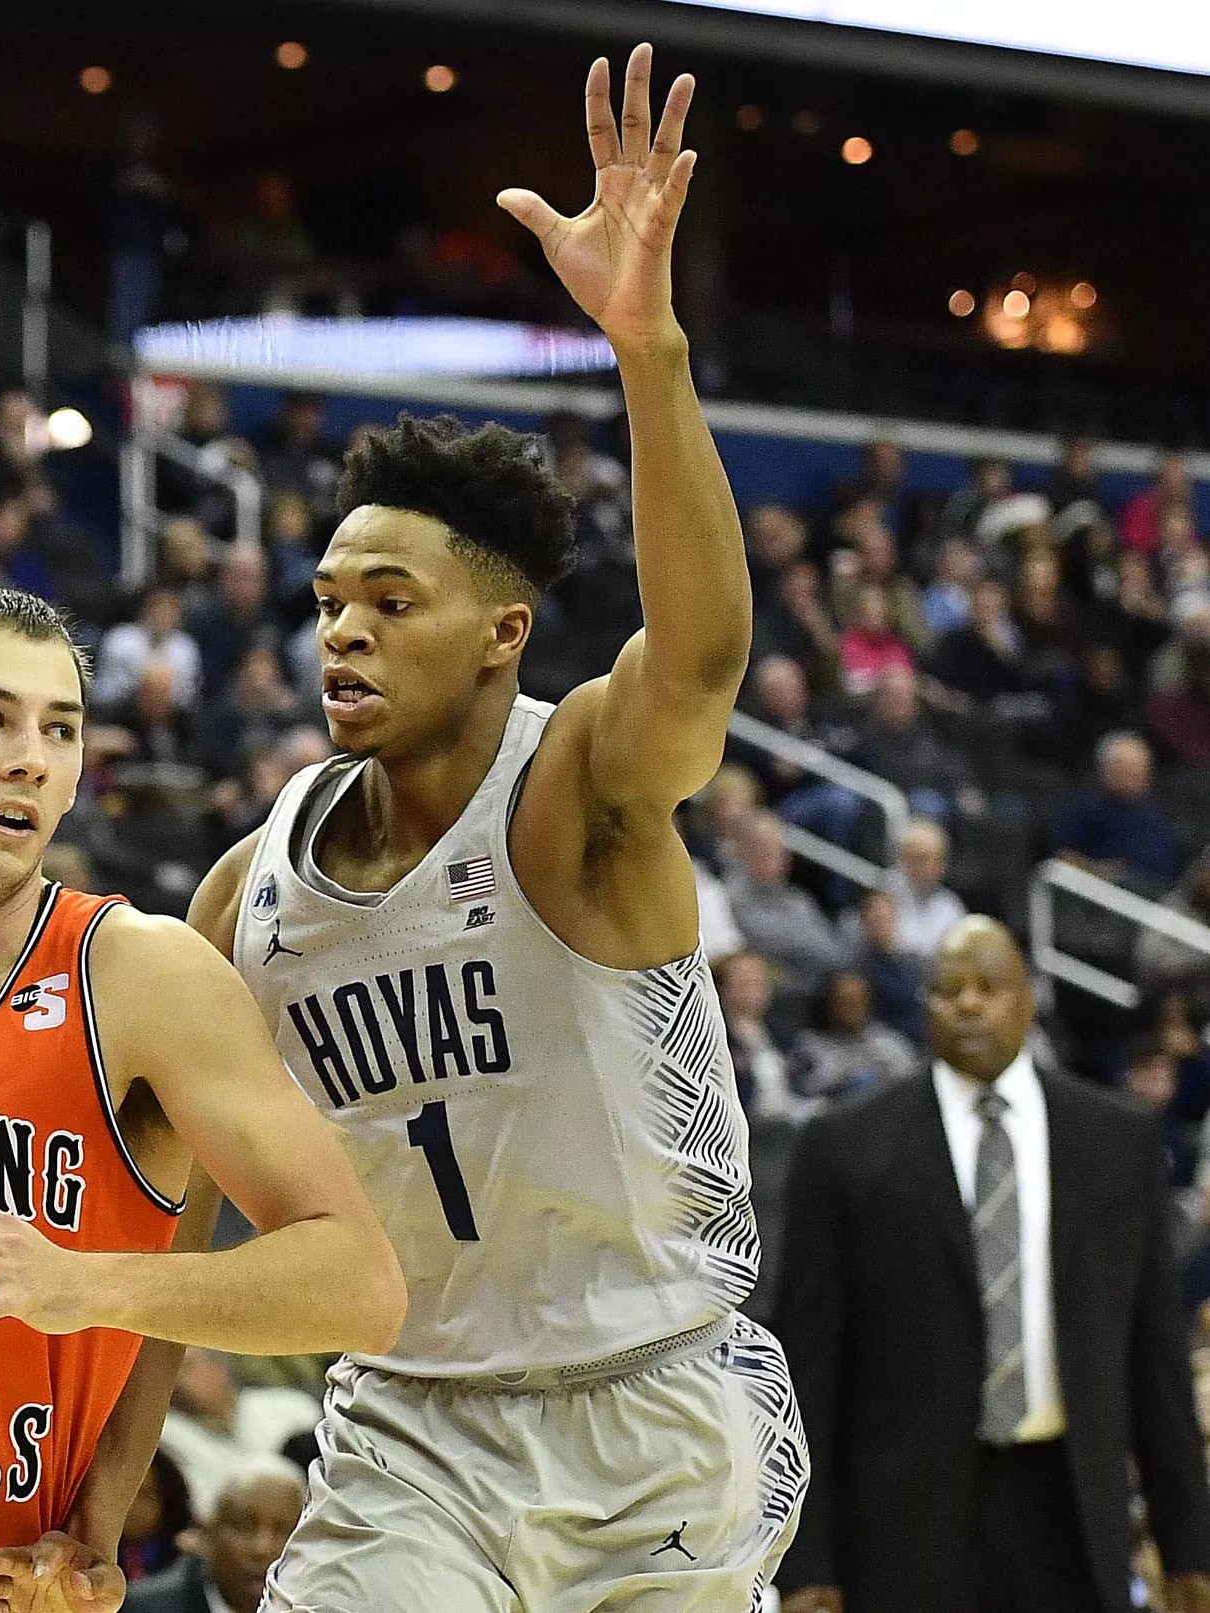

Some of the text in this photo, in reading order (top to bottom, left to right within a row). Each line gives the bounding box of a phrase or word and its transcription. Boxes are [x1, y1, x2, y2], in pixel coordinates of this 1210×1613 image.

[465, 911, 496, 927] EAST
[10, 989, 43, 1007] BIG
[287, 960, 511, 1109] HOYAS
[406, 1100, 481, 1241] 1
